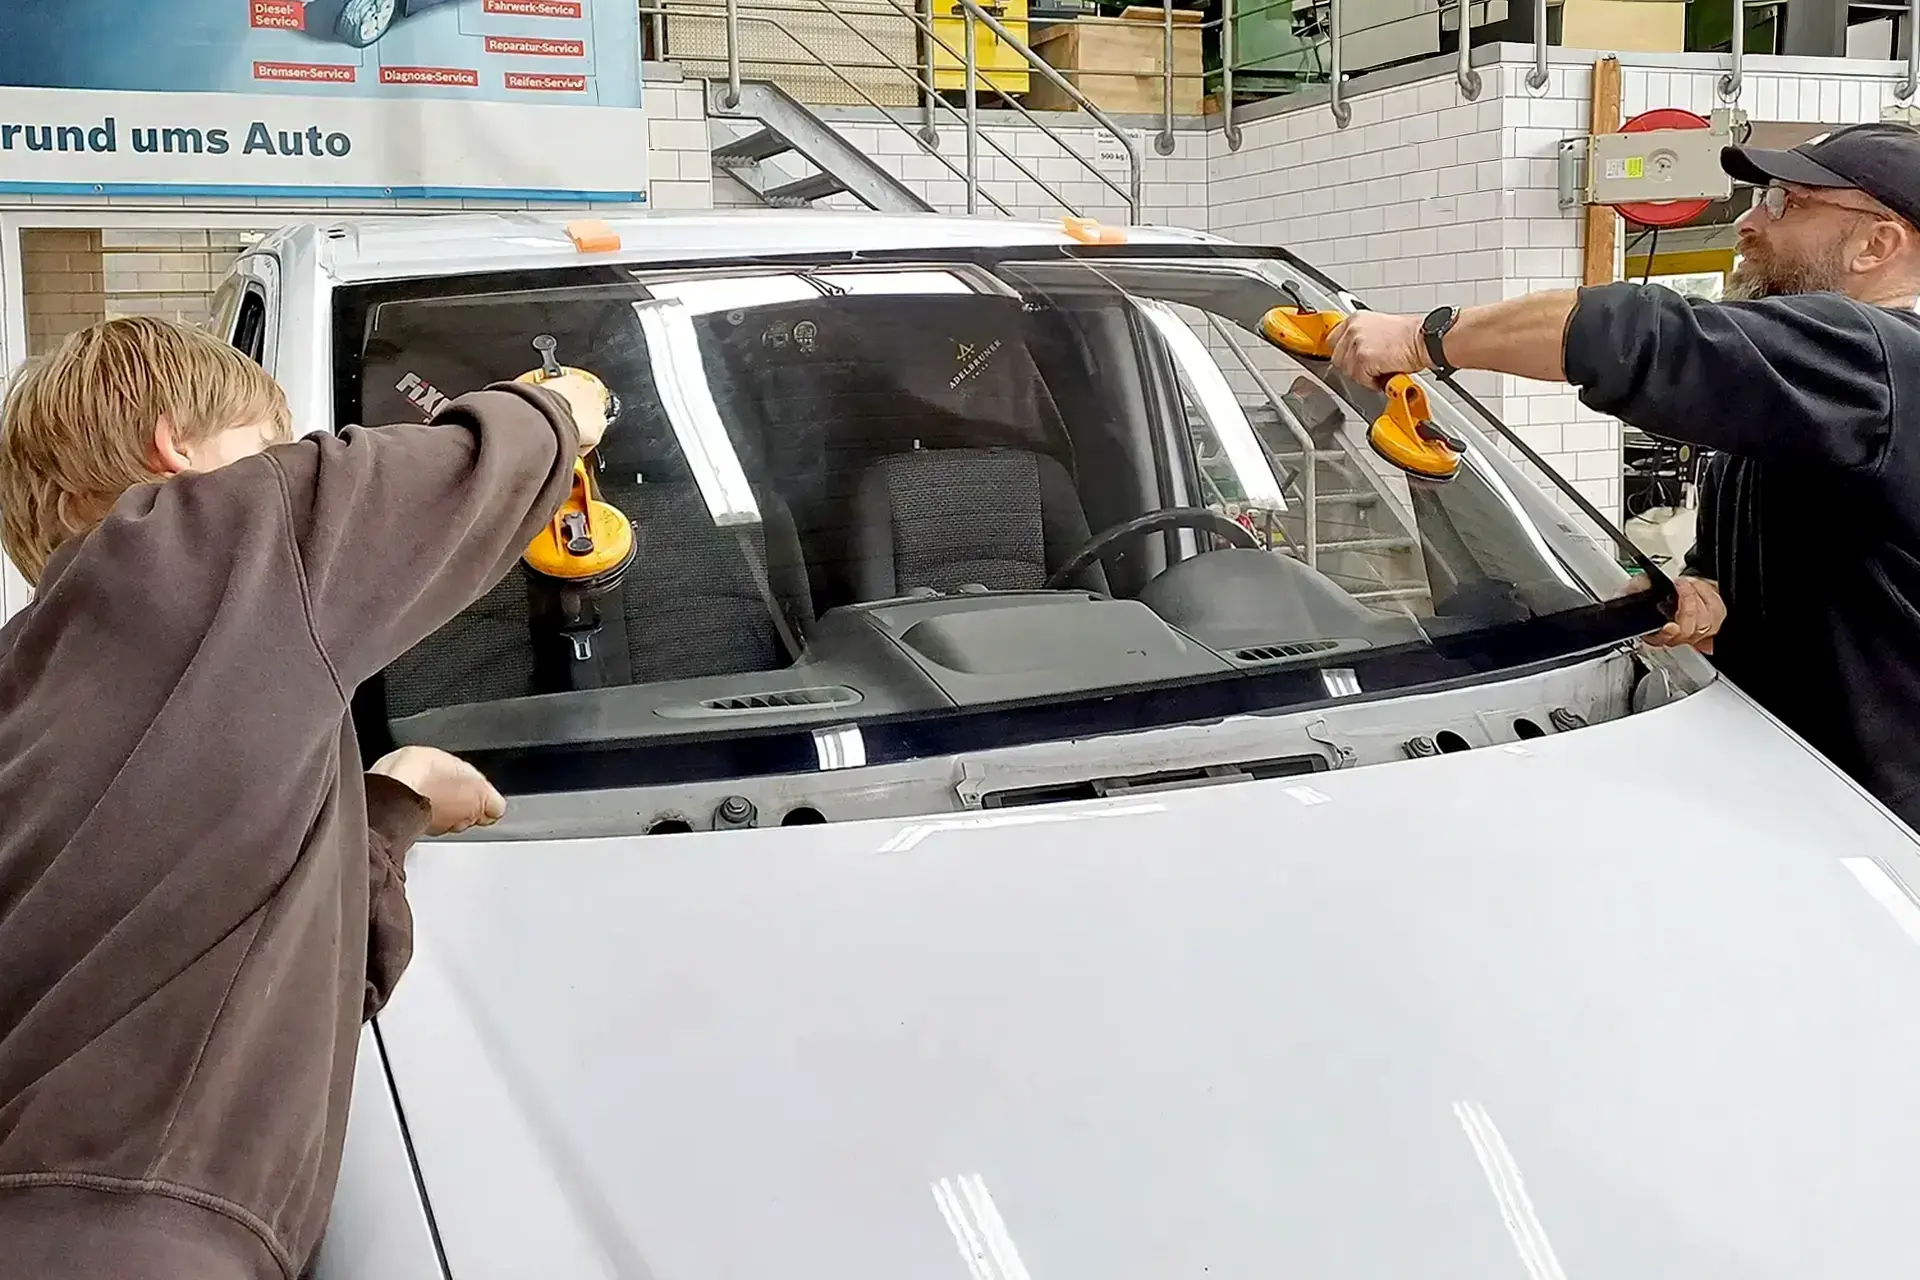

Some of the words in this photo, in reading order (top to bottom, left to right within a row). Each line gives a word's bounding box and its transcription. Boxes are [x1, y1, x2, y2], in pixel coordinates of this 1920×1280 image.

[255, 4, 294, 15] Diesel-
[488, 0, 575, 15] Fahrwerk-Service
[255, 15, 299, 27] Service
[489, 40, 580, 54] Reparatur-Service
[258, 65, 351, 79] Bremsen-Service
[384, 70, 475, 83] Diagnose-Service
[1, 117, 117, 152] rund
[131, 127, 230, 154] ums
[242, 121, 351, 157] Auto
[1101, 152, 1115, 160] 500
